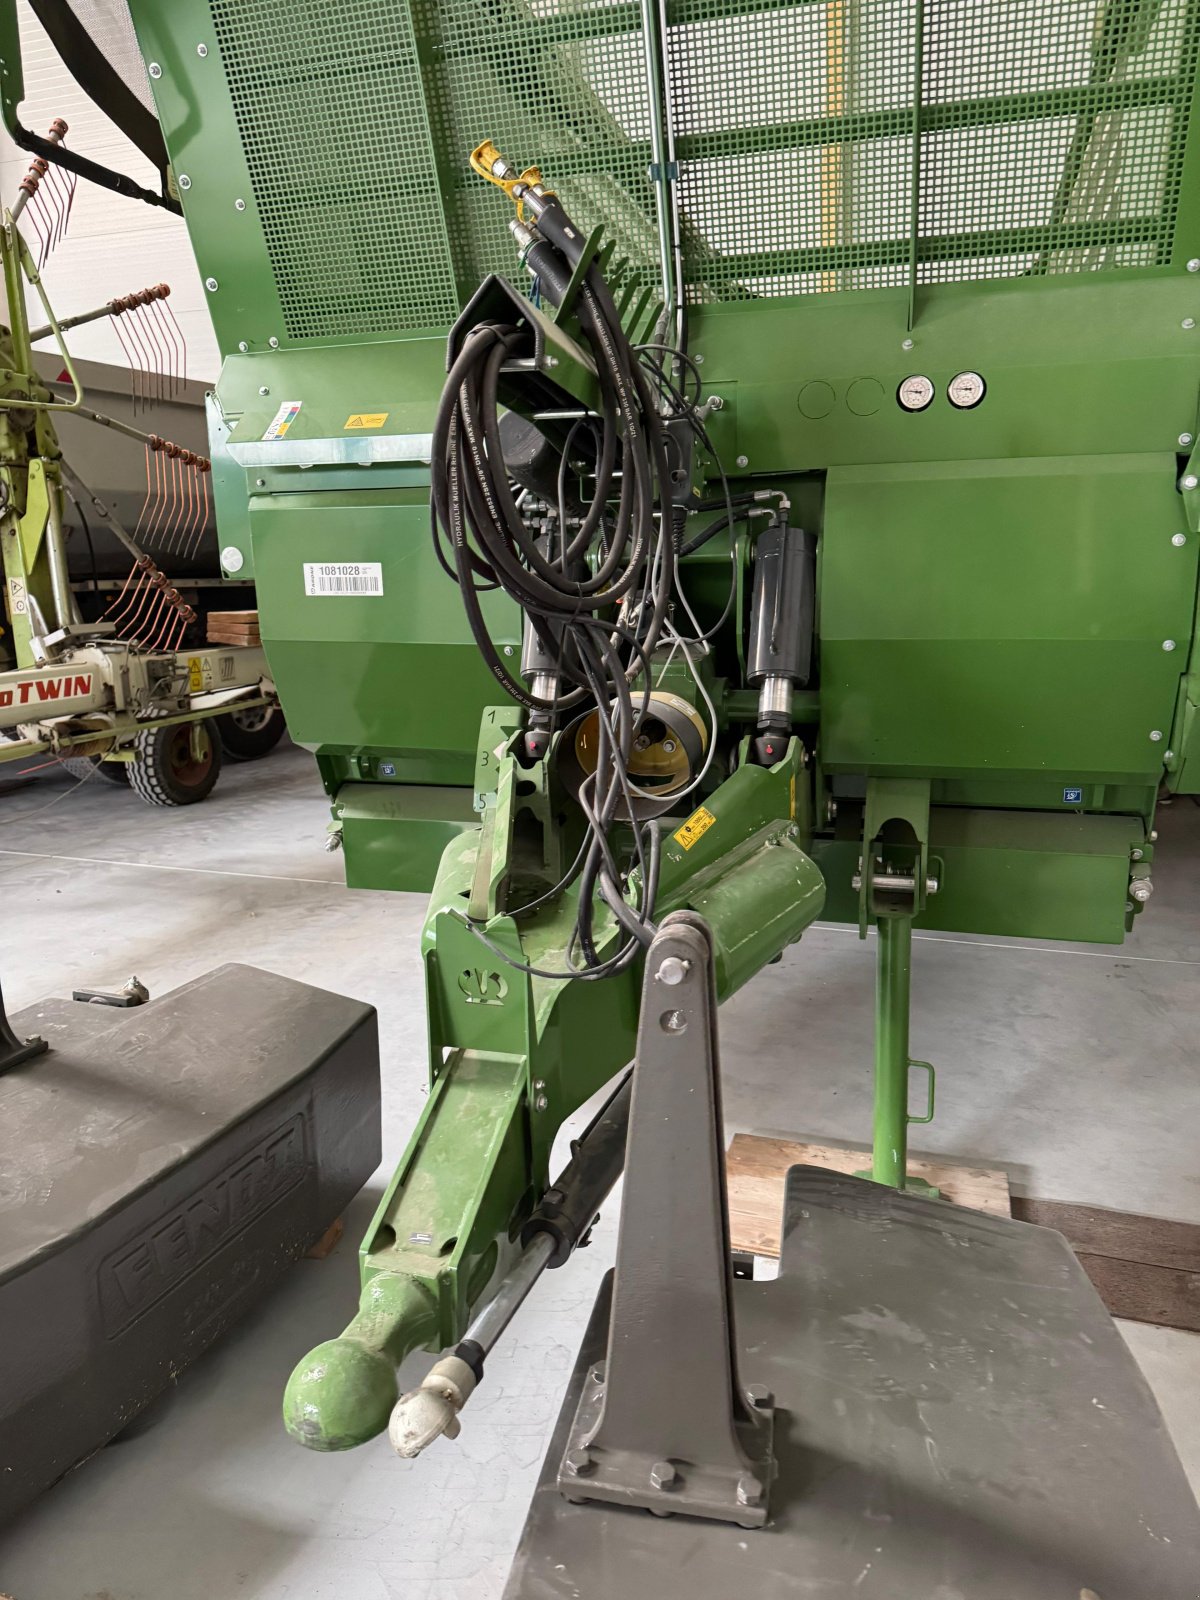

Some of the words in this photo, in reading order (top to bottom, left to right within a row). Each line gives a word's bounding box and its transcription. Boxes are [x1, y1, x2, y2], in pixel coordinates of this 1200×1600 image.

[610, 357, 619, 372] DN10
[464, 412, 472, 424] WP
[624, 408, 633, 421] BAR
[467, 424, 476, 444] MAX.
[628, 422, 637, 438] 10/21
[472, 446, 482, 466] DN10
[477, 466, 486, 481] 3/8"
[451, 466, 459, 502] MUELLER
[481, 481, 490, 497] 2SN
[486, 496, 498, 519] EN853
[454, 503, 464, 547] HYDRAULIK
[319, 566, 360, 576] 1081028
[488, 710, 496, 724] 1
[481, 751, 490, 767] 3
[479, 793, 487, 809] 5
[110, 1126, 297, 1309] FENDT
